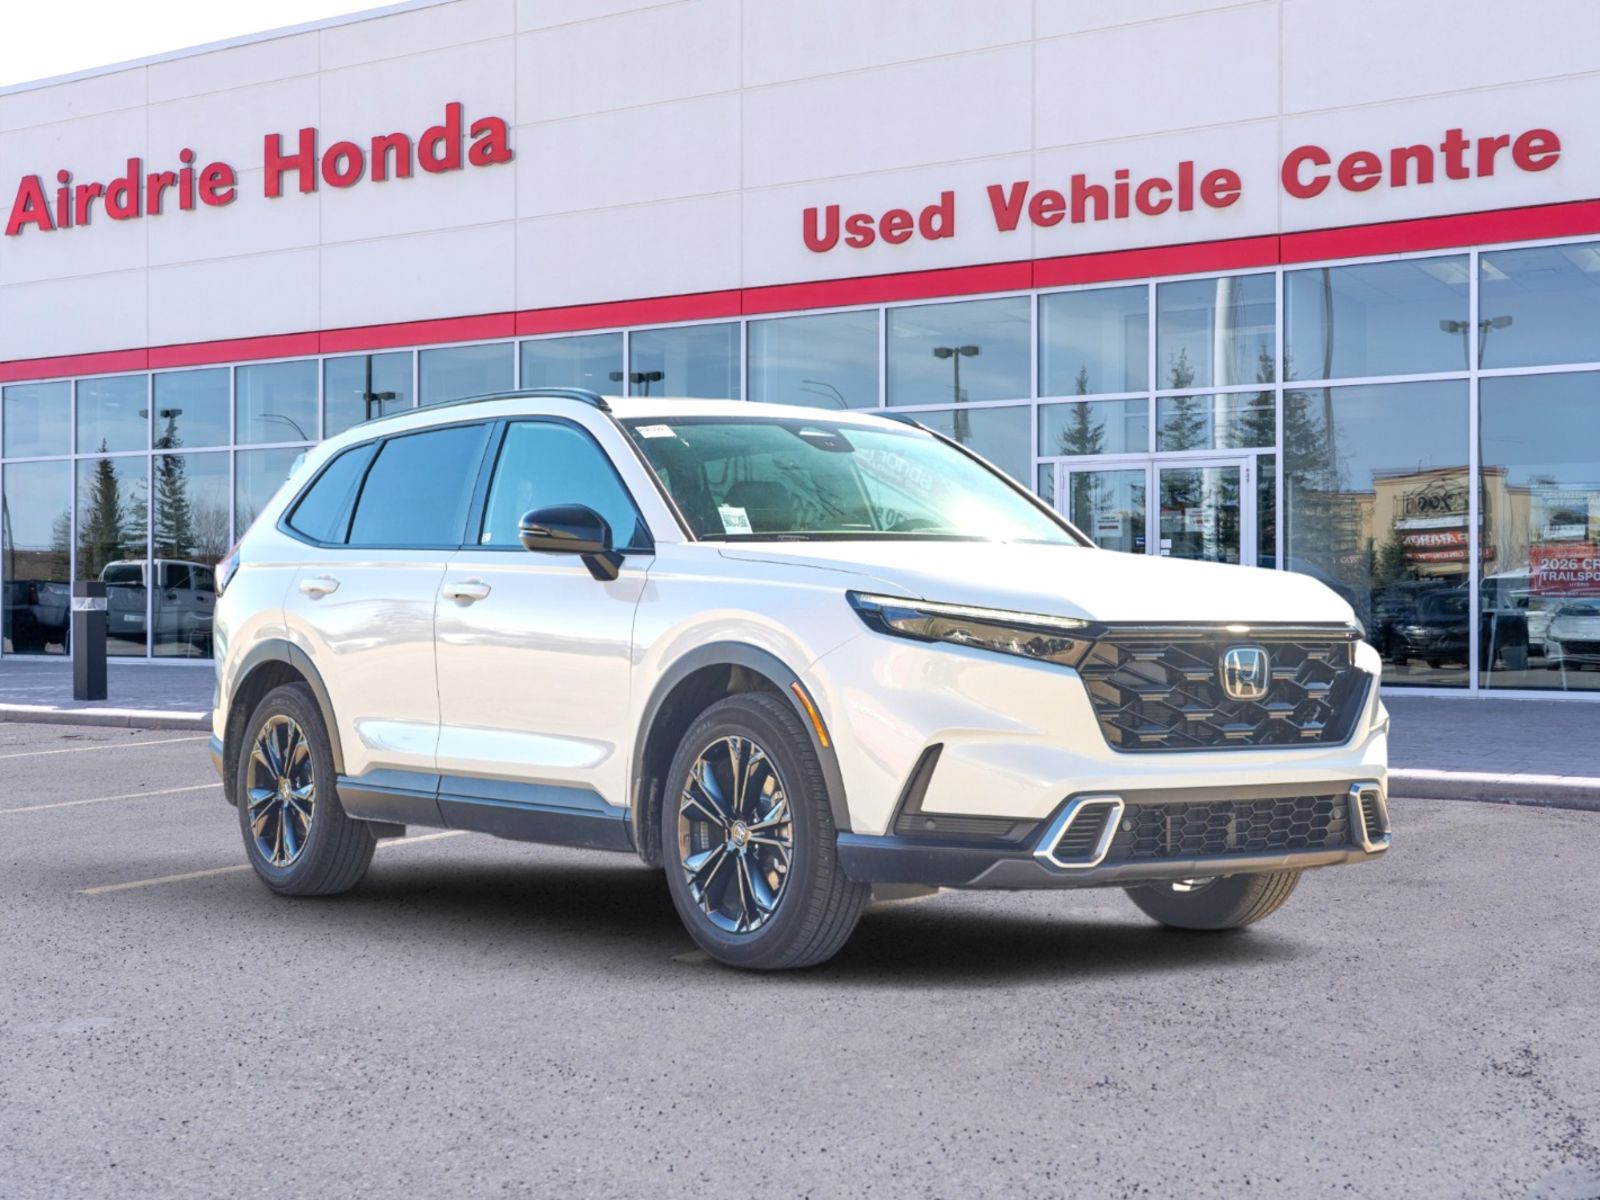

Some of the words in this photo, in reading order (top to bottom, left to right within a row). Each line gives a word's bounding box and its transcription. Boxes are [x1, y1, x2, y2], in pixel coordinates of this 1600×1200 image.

[5, 148, 237, 236] Airdrie
[264, 102, 514, 197] Honda
[803, 191, 955, 252] Used
[987, 161, 1241, 231] Vehicle
[1281, 128, 1561, 198] Centre
[1541, 558, 1577, 570] 2026
